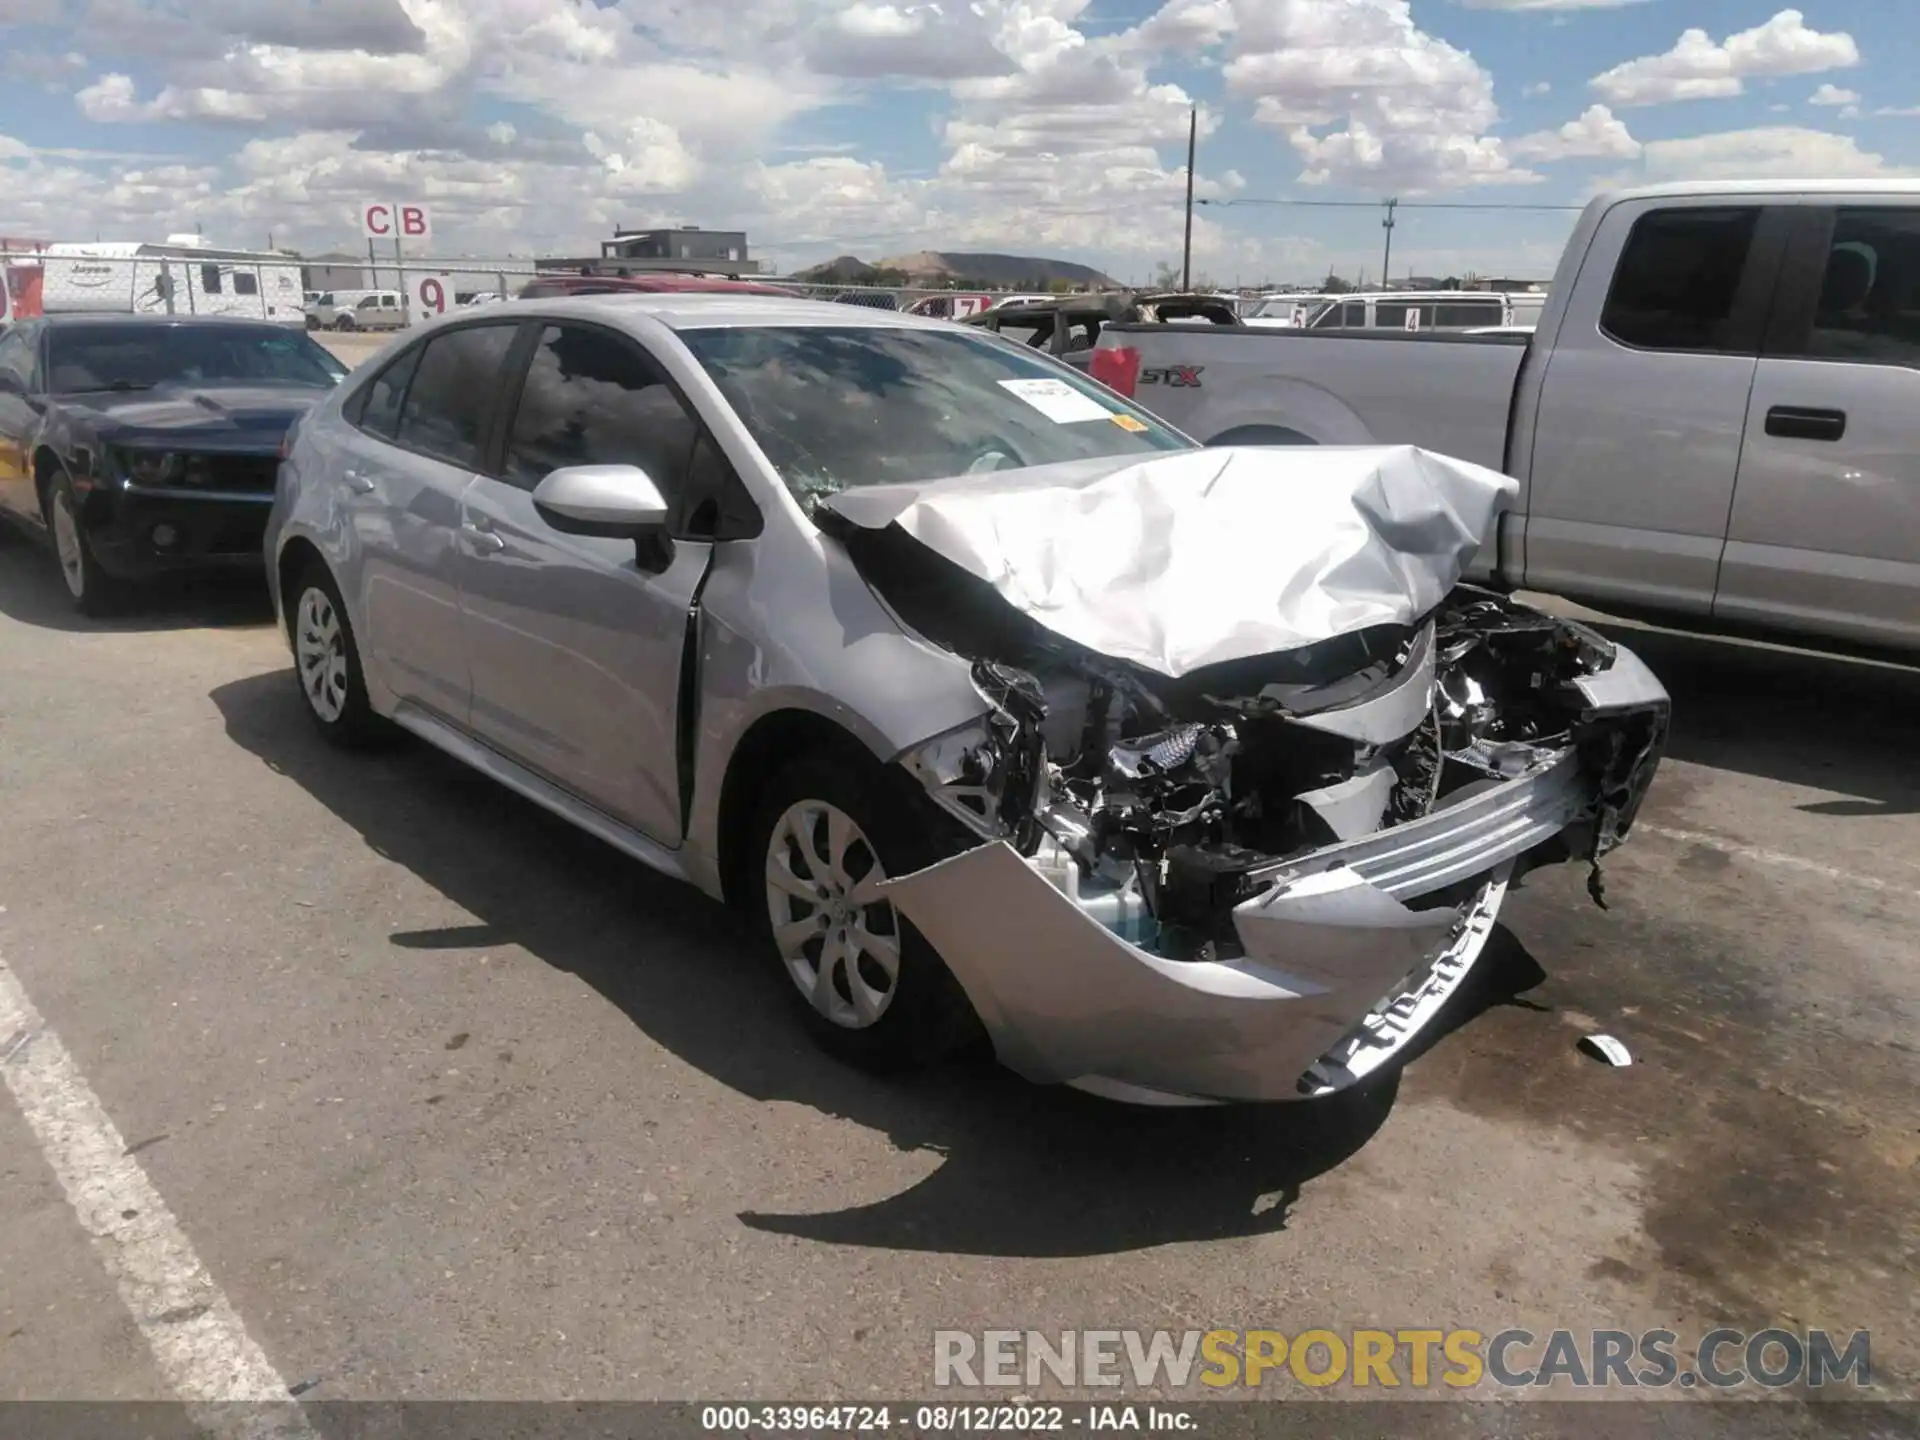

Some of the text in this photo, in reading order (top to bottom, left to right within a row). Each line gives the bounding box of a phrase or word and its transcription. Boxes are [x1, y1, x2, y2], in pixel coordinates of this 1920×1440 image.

[367, 205, 426, 235] C B
[419, 277, 445, 313] 9
[960, 300, 976, 317] 7
[1407, 310, 1417, 331] 4
[1137, 365, 1205, 388] STX
